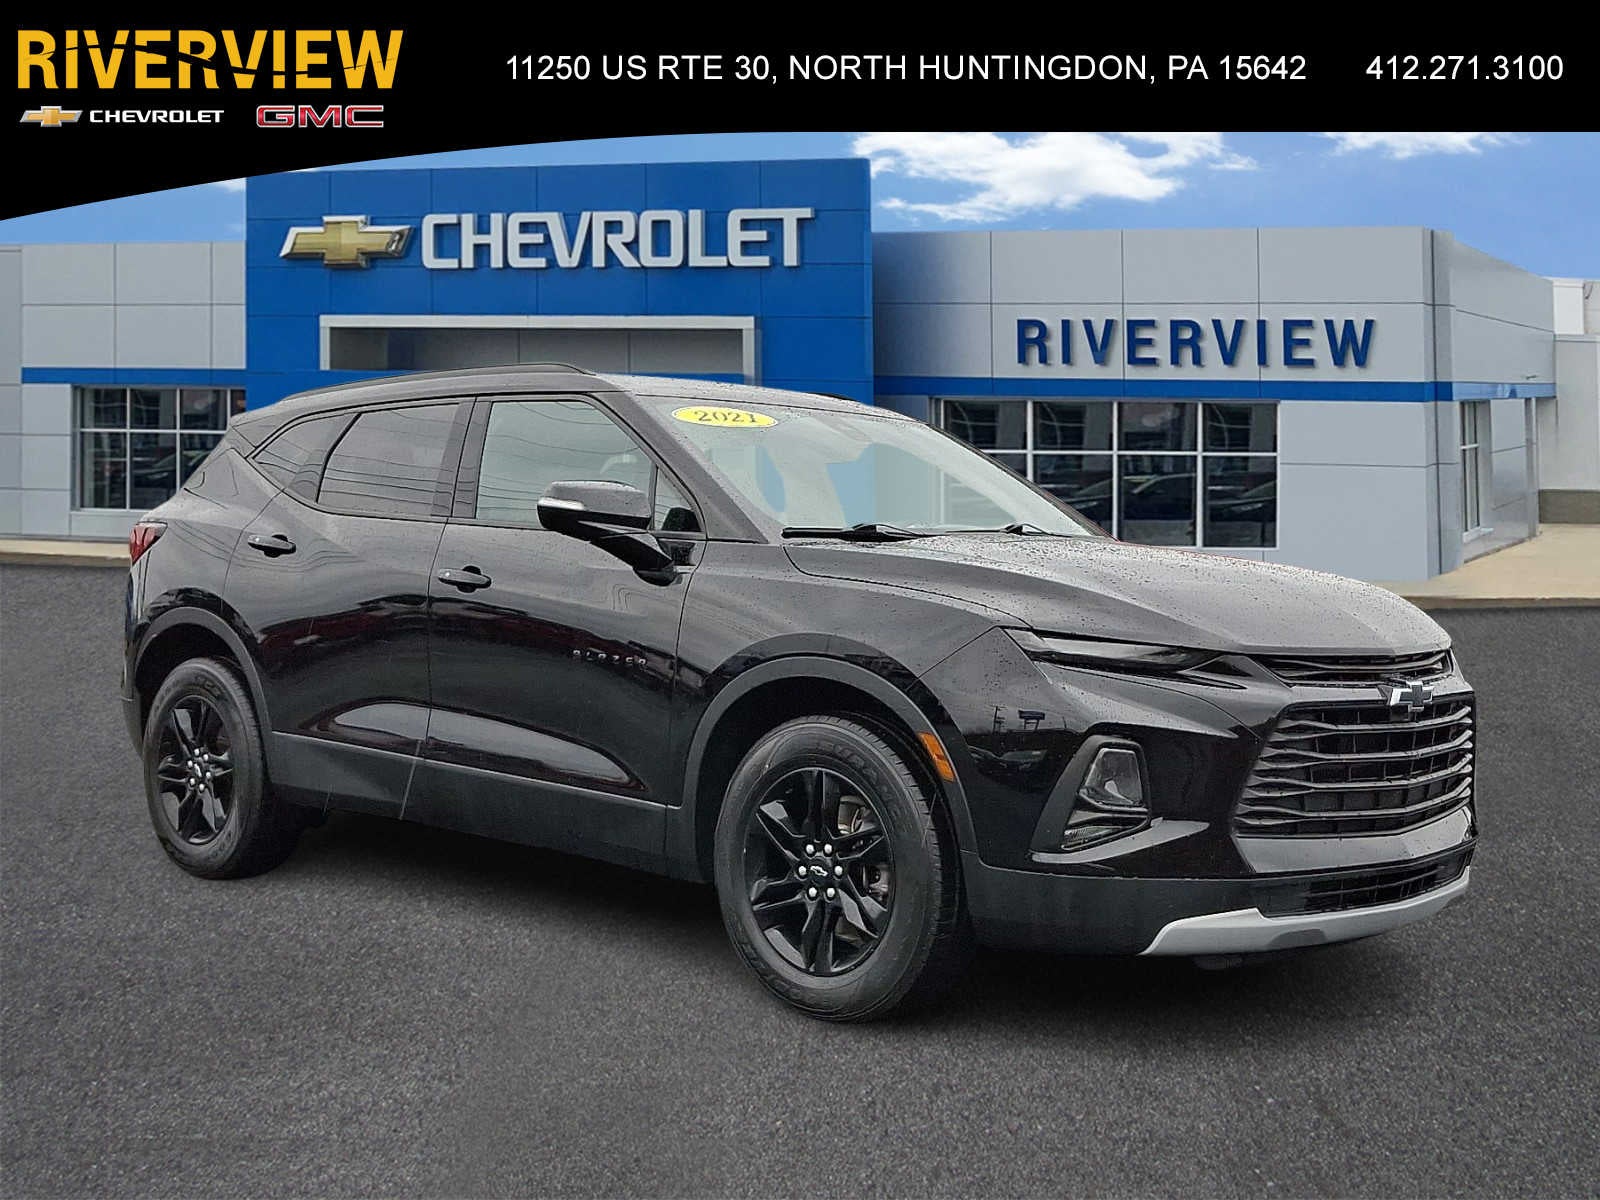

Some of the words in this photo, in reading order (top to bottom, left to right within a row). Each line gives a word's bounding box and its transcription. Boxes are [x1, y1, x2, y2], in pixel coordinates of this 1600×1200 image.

[421, 207, 813, 270] CHEVROLET
[1015, 317, 1376, 368] RIVERVIEW
[694, 409, 757, 423] 2021
